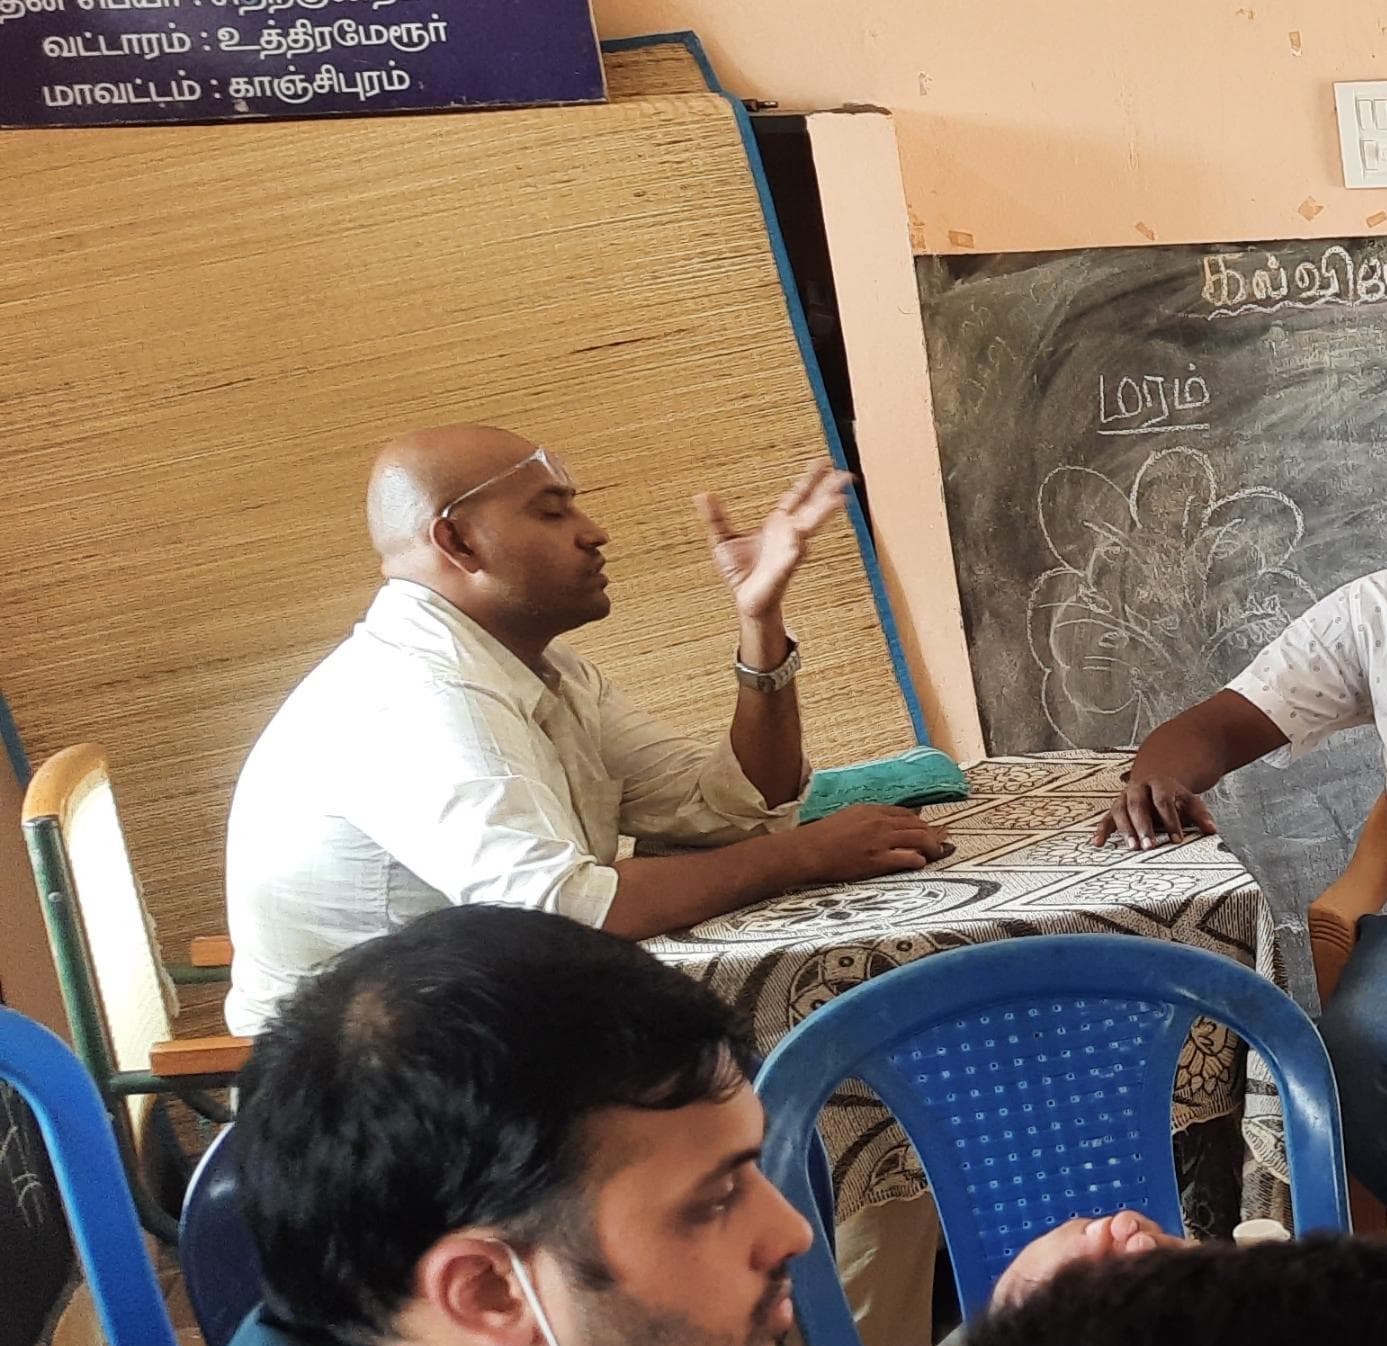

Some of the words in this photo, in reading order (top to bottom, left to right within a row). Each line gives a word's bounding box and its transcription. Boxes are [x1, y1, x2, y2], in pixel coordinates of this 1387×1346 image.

[43, 22, 192, 60] வட்டாரம்
[217, 13, 448, 60] உத்திரமேரூர்
[42, 69, 201, 107] மாவட்டம்
[228, 60, 410, 104] காஞ்சிபுரம்
